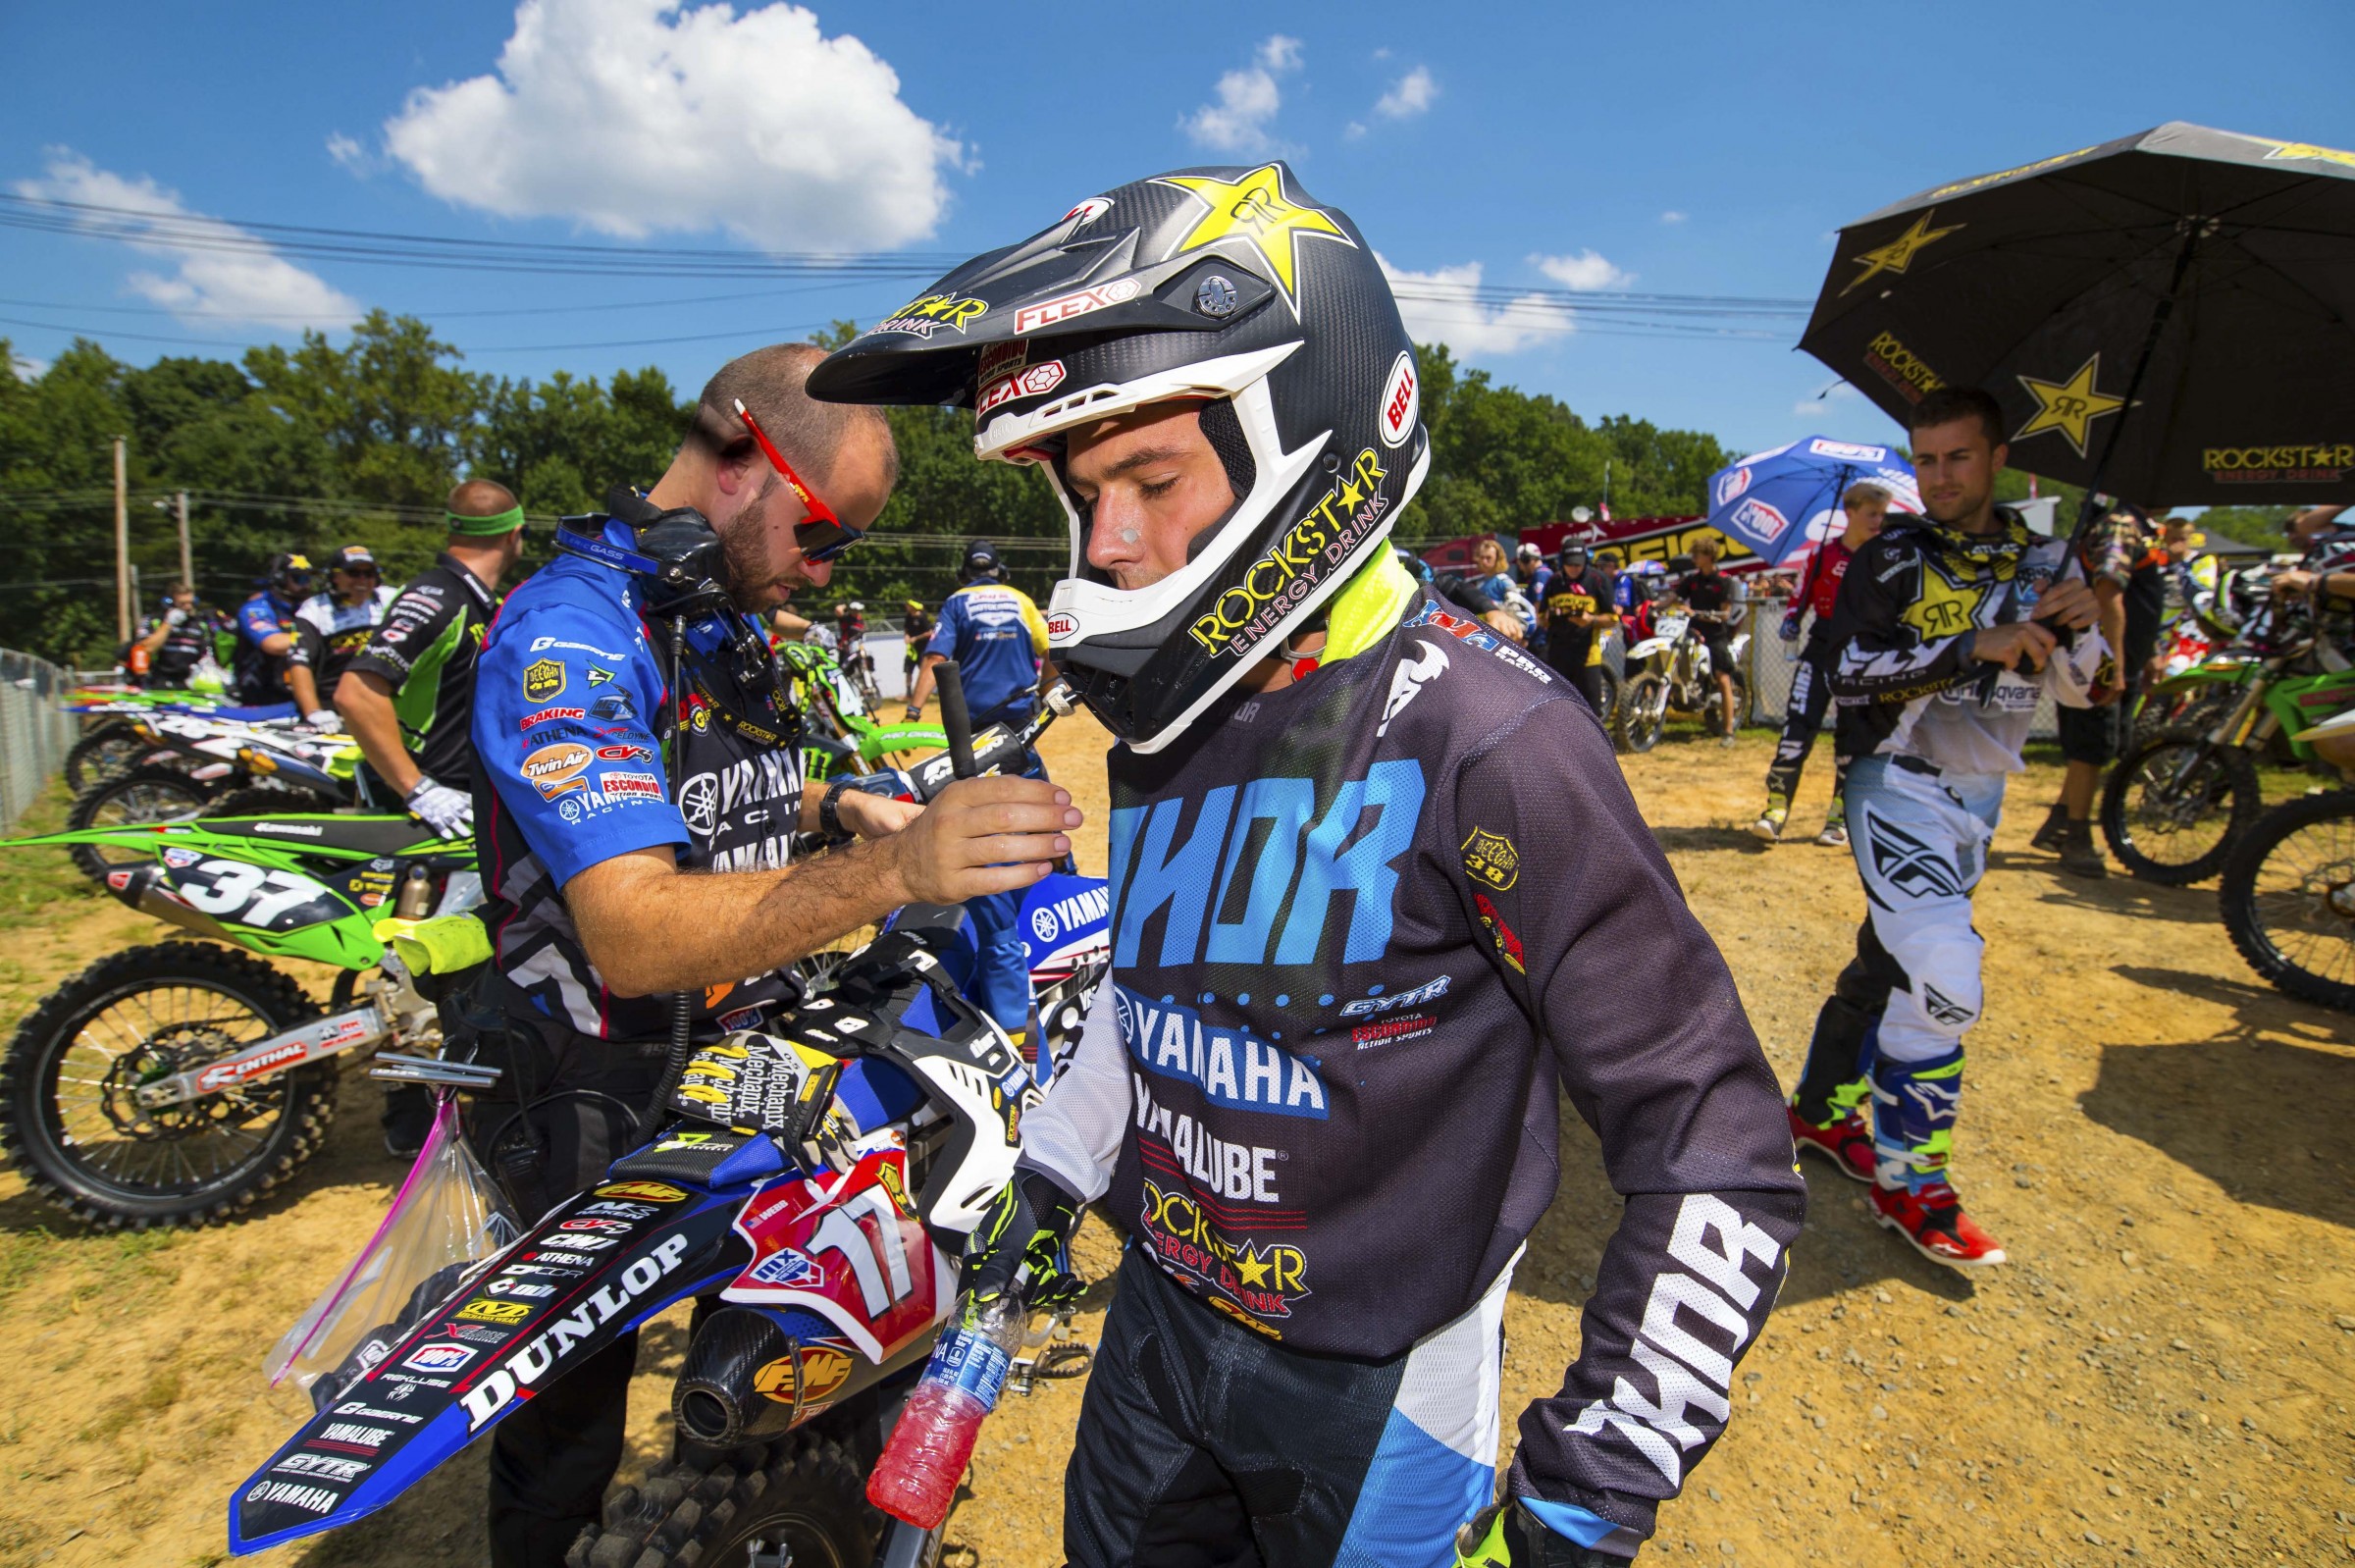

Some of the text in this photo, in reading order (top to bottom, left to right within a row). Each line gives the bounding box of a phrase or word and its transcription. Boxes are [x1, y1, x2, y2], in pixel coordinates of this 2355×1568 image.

[1386, 363, 1416, 434] BELL
[590, 544, 625, 560] GASS
[1230, 491, 1385, 653] ENERGY DRINK
[1048, 619, 1072, 633] BELL
[520, 707, 586, 731] BRAKING
[530, 726, 587, 748] ATHENA
[528, 751, 589, 777] Twin Air
[622, 773, 654, 782] TOYOTA
[181, 860, 327, 928] 37
[761, 1058, 794, 1129] Mechanix
[535, 1251, 595, 1267] ATHENA
[459, 1233, 689, 1433] DUNLOP
[413, 1349, 469, 1367] 100%
[381, 1373, 452, 1388] REKLUSE
[320, 1423, 392, 1447] YAMALUBE
[263, 1482, 339, 1514] YAMAHA
